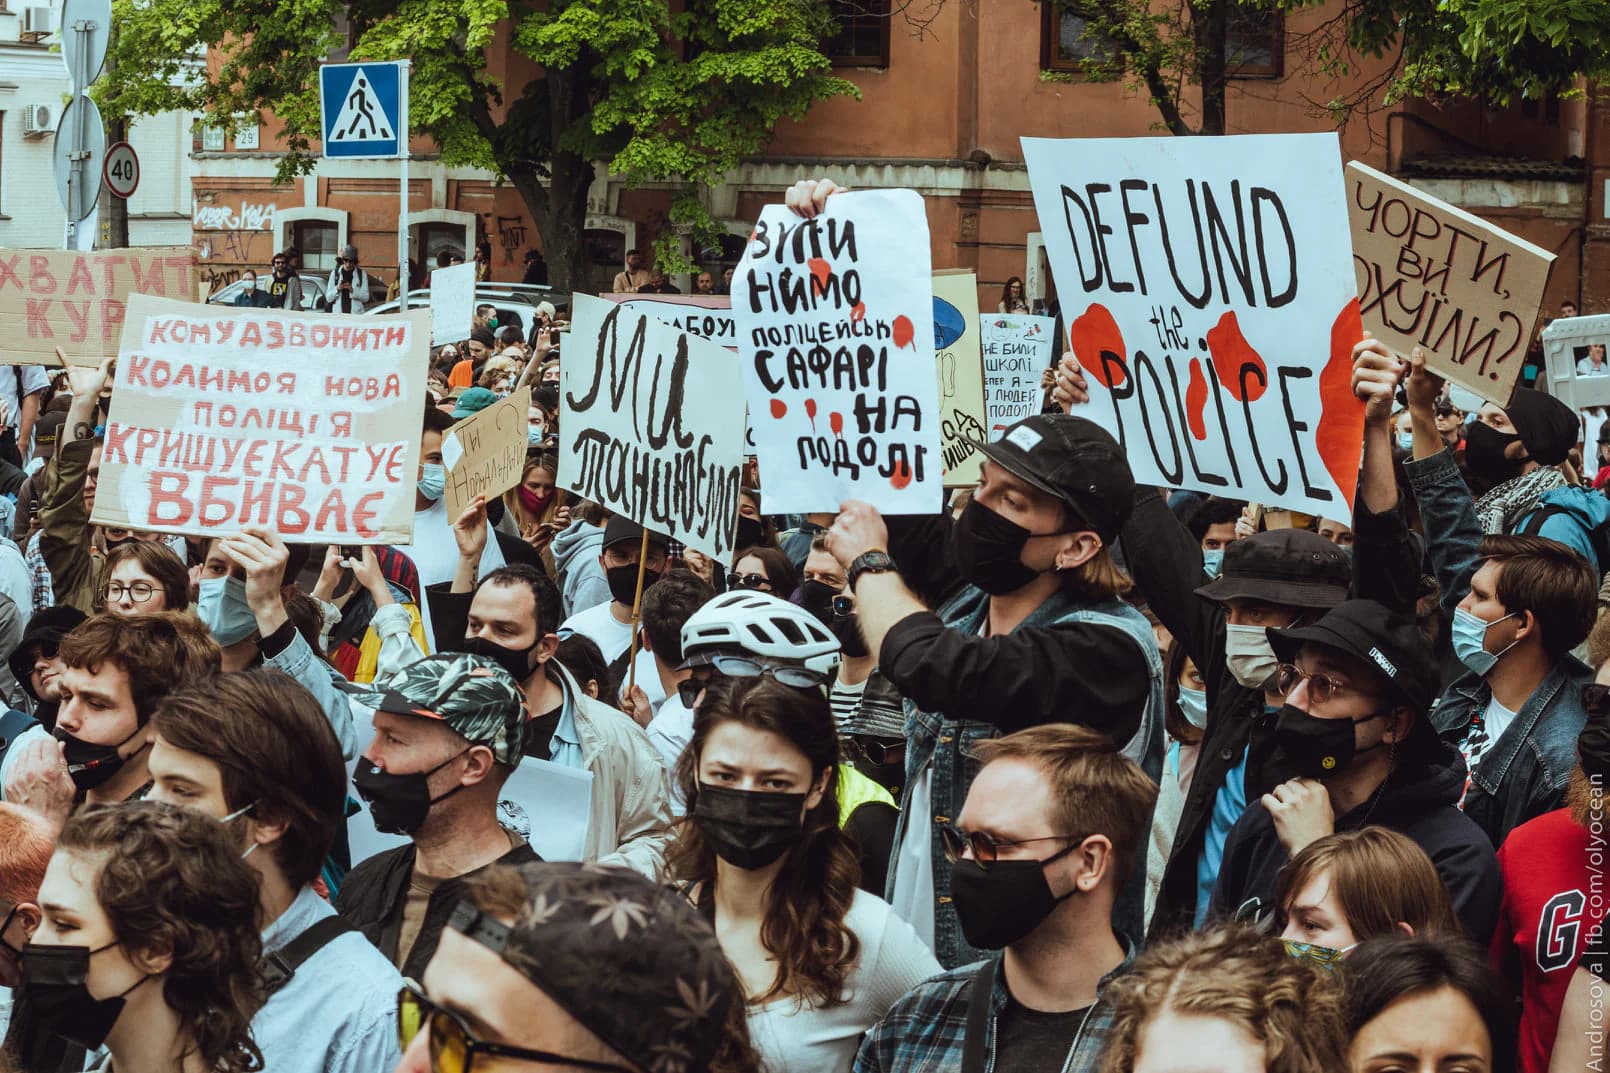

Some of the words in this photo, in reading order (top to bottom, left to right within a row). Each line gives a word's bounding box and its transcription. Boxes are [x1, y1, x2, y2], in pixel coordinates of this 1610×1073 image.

[112, 160, 132, 180] 40
[751, 217, 858, 264] ЗУПИ
[1061, 178, 1298, 309] DEFUND
[1356, 181, 1511, 300] ЧОРТИ,
[0, 254, 198, 297] ХВАТИТ
[747, 267, 862, 315] НИМО
[1396, 245, 1453, 297] ВИ
[751, 317, 912, 348] ПОЛІЦЕЙСЬК
[1003, 343, 1037, 356] БИЛИ
[1149, 304, 1189, 351] the
[325, 373, 401, 401] НОВА
[754, 345, 888, 394] САФАРІ
[1011, 376, 1020, 387] Я
[853, 393, 922, 434] НА
[996, 388, 1037, 402] ЛЮДЕЙ
[194, 401, 353, 439] ПОЛІЦІЯ
[1101, 346, 1333, 501] POLICE
[147, 470, 385, 538] ВБИВАЄ
[1537, 889, 1586, 973] G
